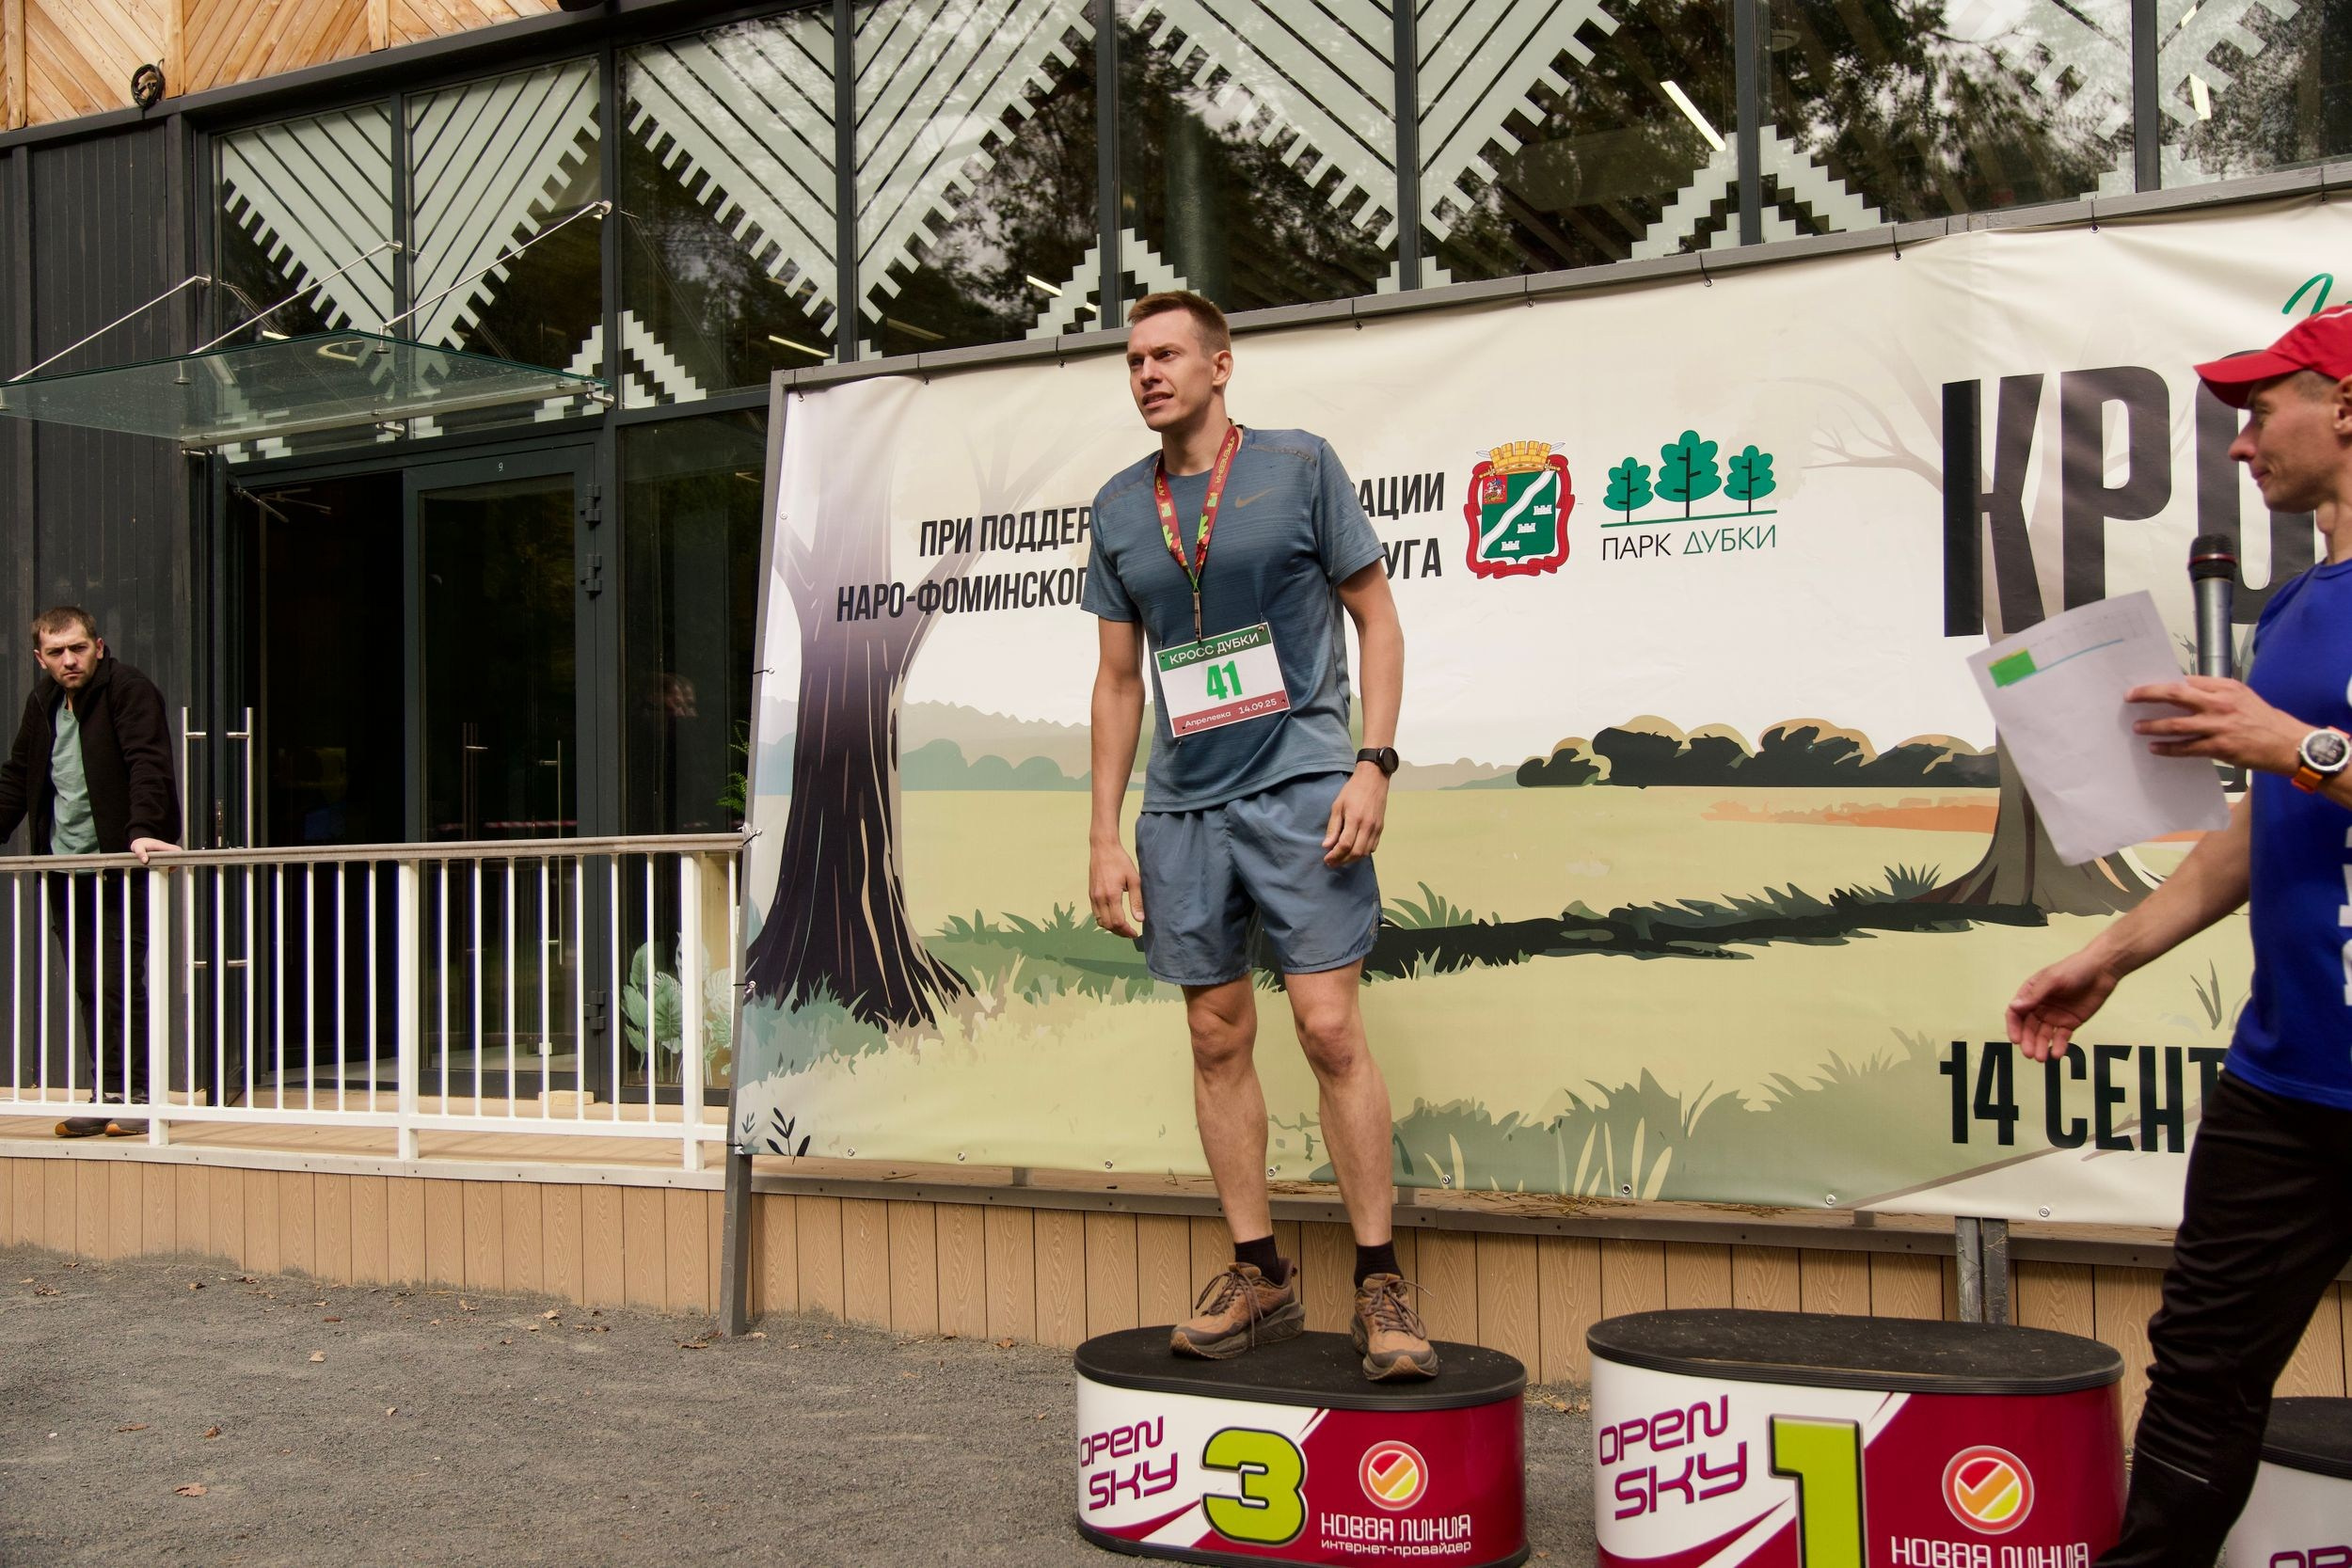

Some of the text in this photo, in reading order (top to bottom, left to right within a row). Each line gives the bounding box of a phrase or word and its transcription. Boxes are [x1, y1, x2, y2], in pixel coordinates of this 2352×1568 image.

[1351, 472, 1444, 520] АЦИИ
[919, 517, 973, 557] ПРИ
[1602, 525, 1776, 561] ПАРК ДУБКИ
[1169, 632, 1260, 665] КРОСС ДУБКИ
[1206, 660, 1243, 701] 41
[1184, 698, 1277, 729] Апрелевка 14.09.25
[1940, 1041, 2019, 1146] 14
[1089, 1452, 1178, 1511] SKY
[1201, 1426, 1308, 1547] 3
[1614, 1441, 1747, 1520] SKY
[1767, 1413, 1868, 1568] 1
[1321, 1512, 1471, 1542] НОВАЯ ЛИНИЯ
[1321, 1539, 1472, 1558] интернет-провайдер
